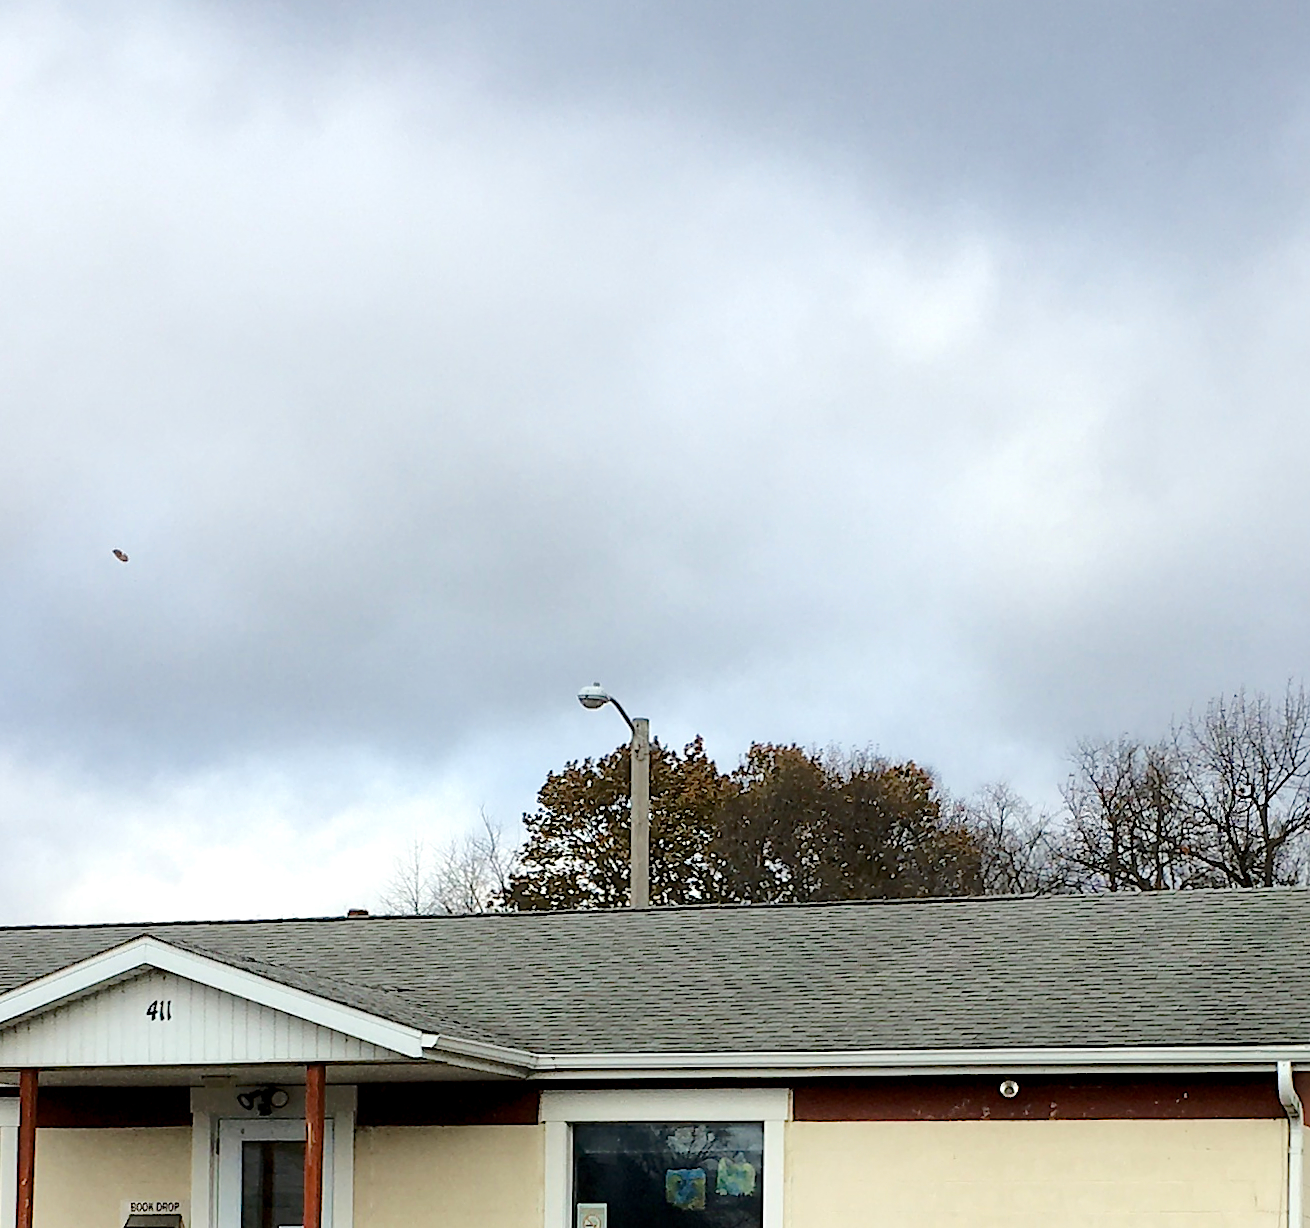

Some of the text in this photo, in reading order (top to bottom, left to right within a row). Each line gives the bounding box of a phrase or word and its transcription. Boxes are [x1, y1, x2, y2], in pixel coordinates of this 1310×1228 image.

[147, 1000, 171, 1021] 411
[131, 1202, 179, 1212] BOOK DROP
